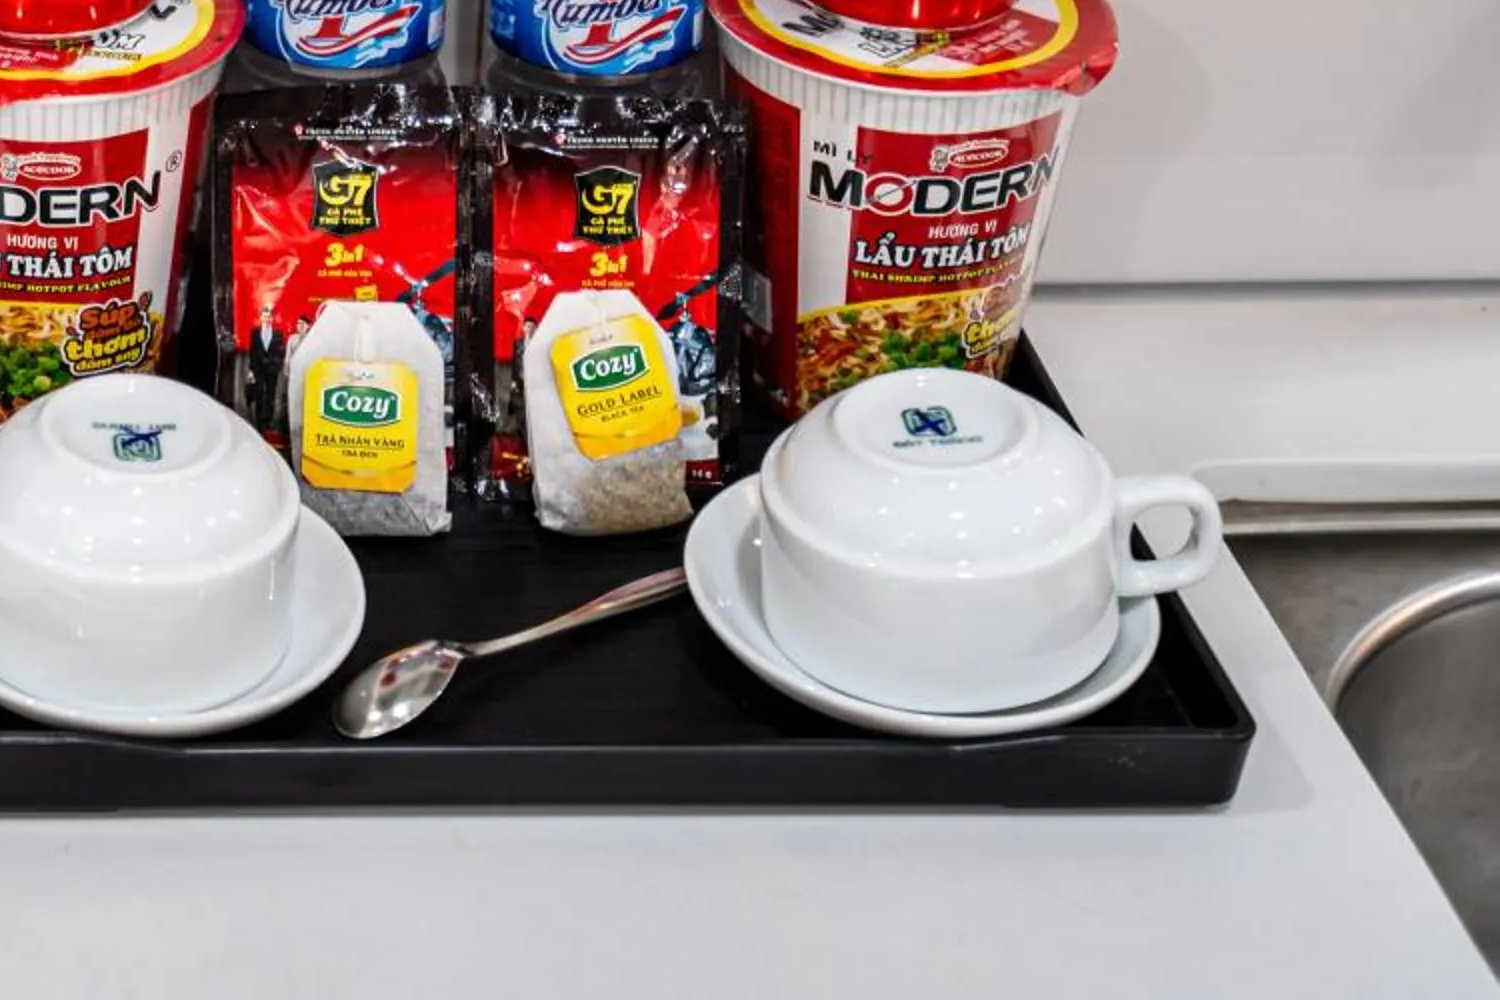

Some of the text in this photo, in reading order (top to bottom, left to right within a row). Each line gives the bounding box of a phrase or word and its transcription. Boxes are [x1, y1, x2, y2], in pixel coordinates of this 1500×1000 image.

[319, 173, 373, 206] G7
[809, 145, 1060, 214] MODERN
[581, 183, 635, 215] G7
[7, 233, 80, 251] HƯƠNG VỊ
[854, 232, 916, 268] LẨU
[921, 238, 987, 269] THÁI
[7, 250, 74, 279] THÁI
[80, 244, 133, 277] TÔM
[580, 351, 637, 381] Cozy
[329, 390, 391, 418] Cozy
[577, 385, 662, 416] GOLD LABEL
